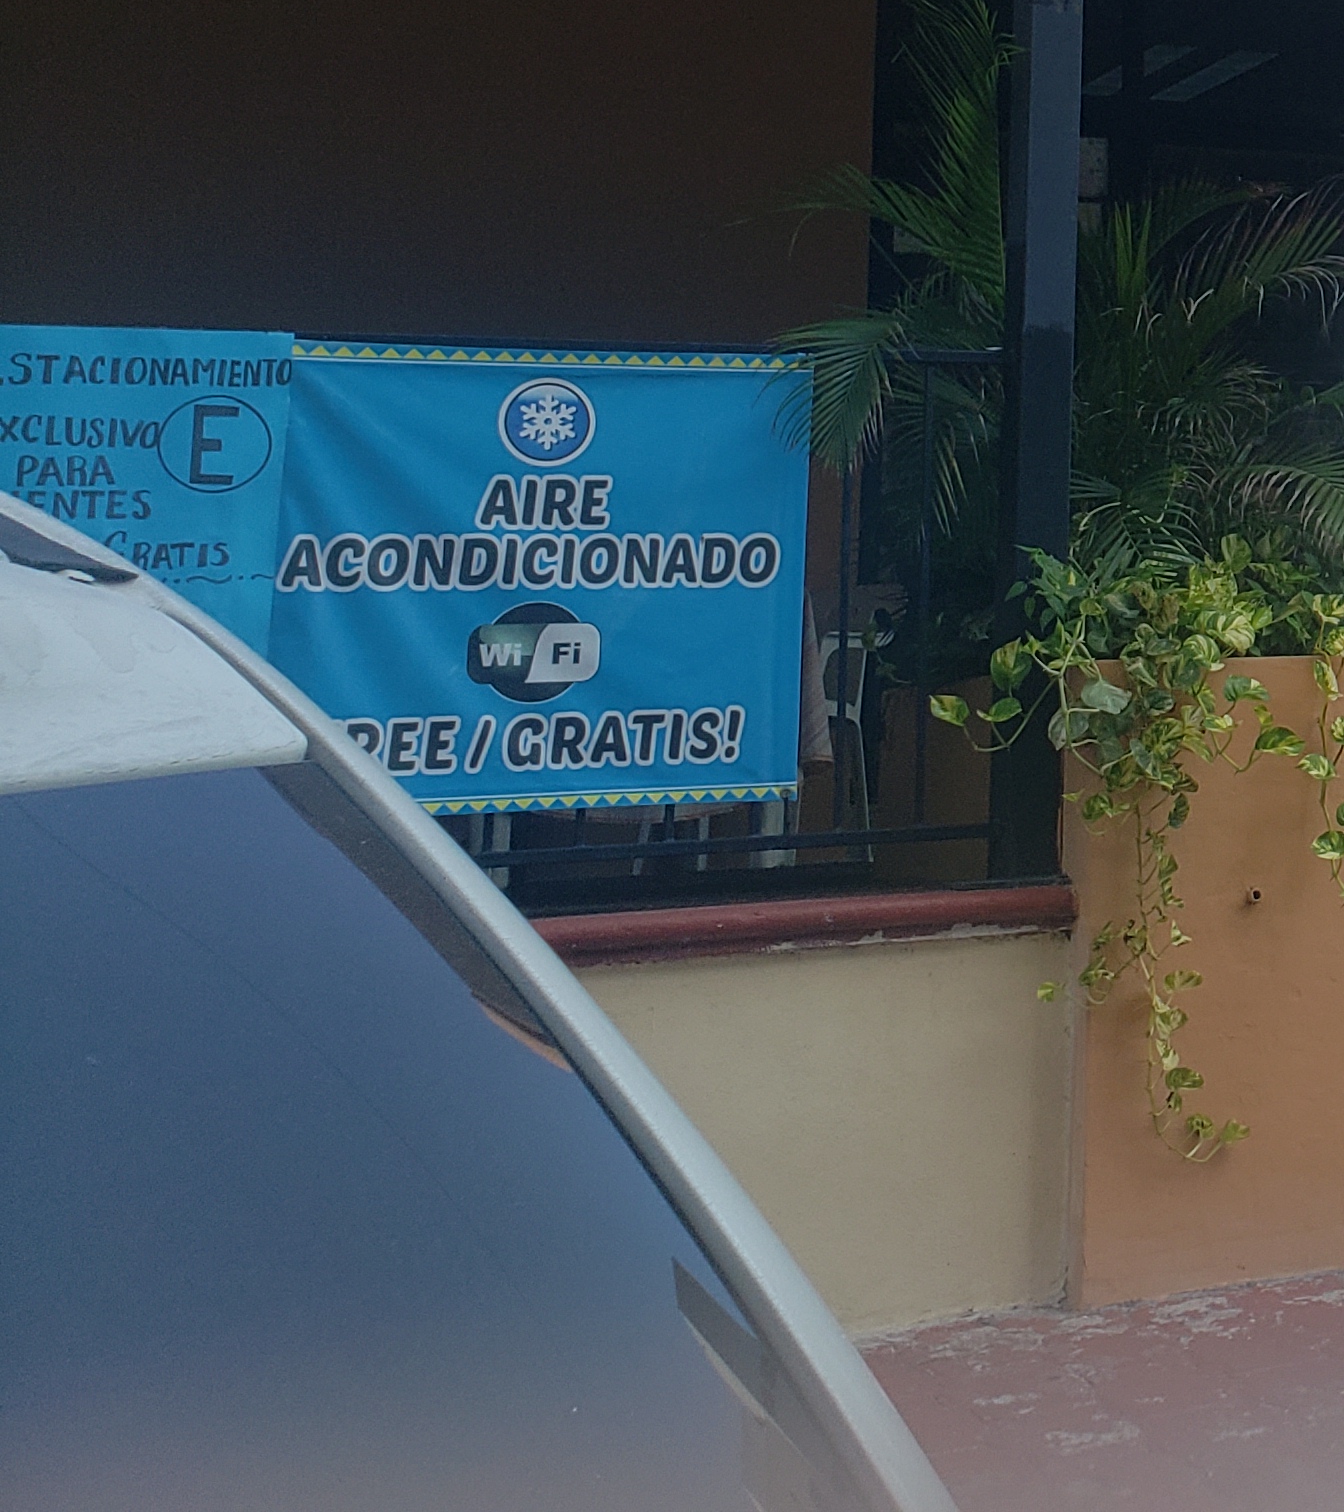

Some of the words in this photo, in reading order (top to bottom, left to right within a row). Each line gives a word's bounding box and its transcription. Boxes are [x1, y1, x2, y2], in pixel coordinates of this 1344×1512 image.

[0, 351, 293, 388] STACIONAMIENTO
[0, 414, 161, 450] XCLUSIVO
[189, 404, 240, 486] E
[16, 454, 116, 487] PARA
[14, 489, 152, 521] ENTES
[476, 474, 613, 530] AIRE
[278, 533, 782, 591] ACONDICIONADO
[479, 642, 523, 667] Wi
[551, 641, 582, 665] Fi
[336, 716, 460, 776] REE
[504, 705, 746, 772] GRATIS!
